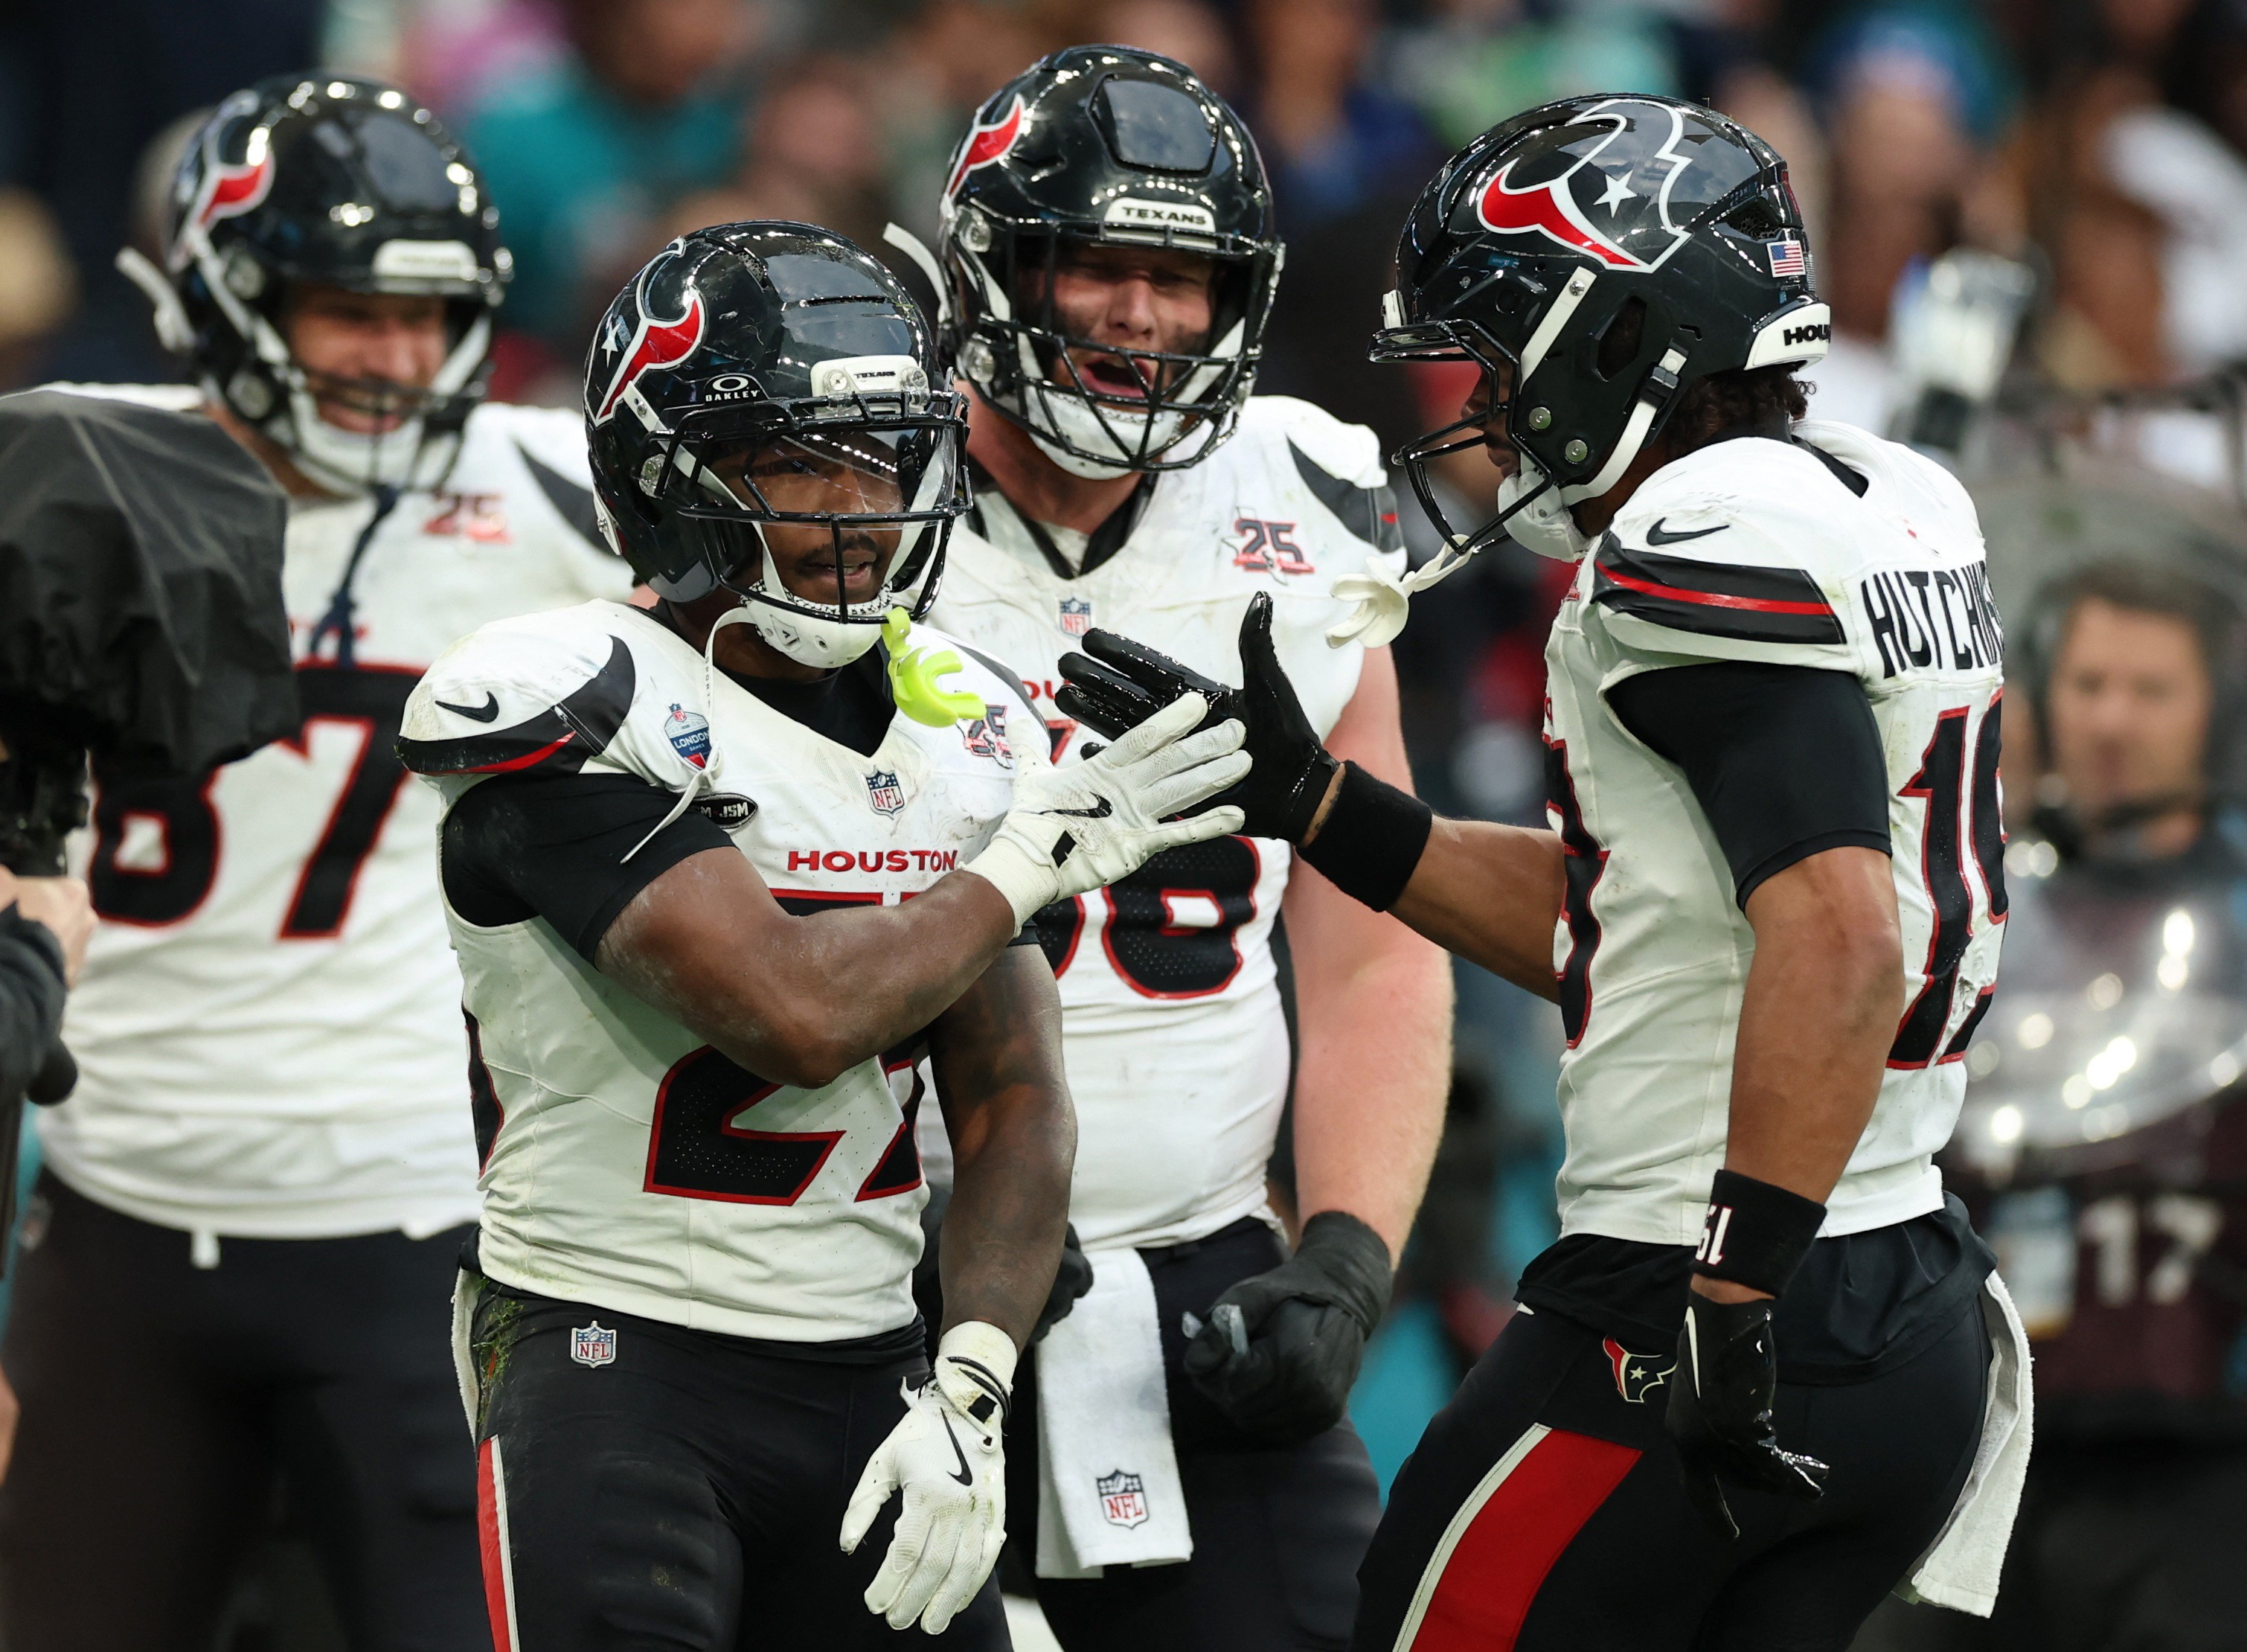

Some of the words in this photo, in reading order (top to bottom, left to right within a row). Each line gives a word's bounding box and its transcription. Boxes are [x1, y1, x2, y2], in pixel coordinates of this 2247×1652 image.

[1122, 207, 1206, 224] TEXANS
[1783, 324, 1831, 346] HOU
[705, 389, 759, 403] OAKLEY
[1233, 518, 1306, 574] 25
[1063, 615, 1090, 634] NFL
[673, 730, 710, 749] LONDON
[873, 788, 902, 810] NFL
[719, 801, 749, 819] JSM
[787, 850, 958, 873] HOUSTON
[2080, 1195, 2222, 1307] 17
[579, 1342, 609, 1360] NFL
[1106, 1493, 1144, 1520] NFL
